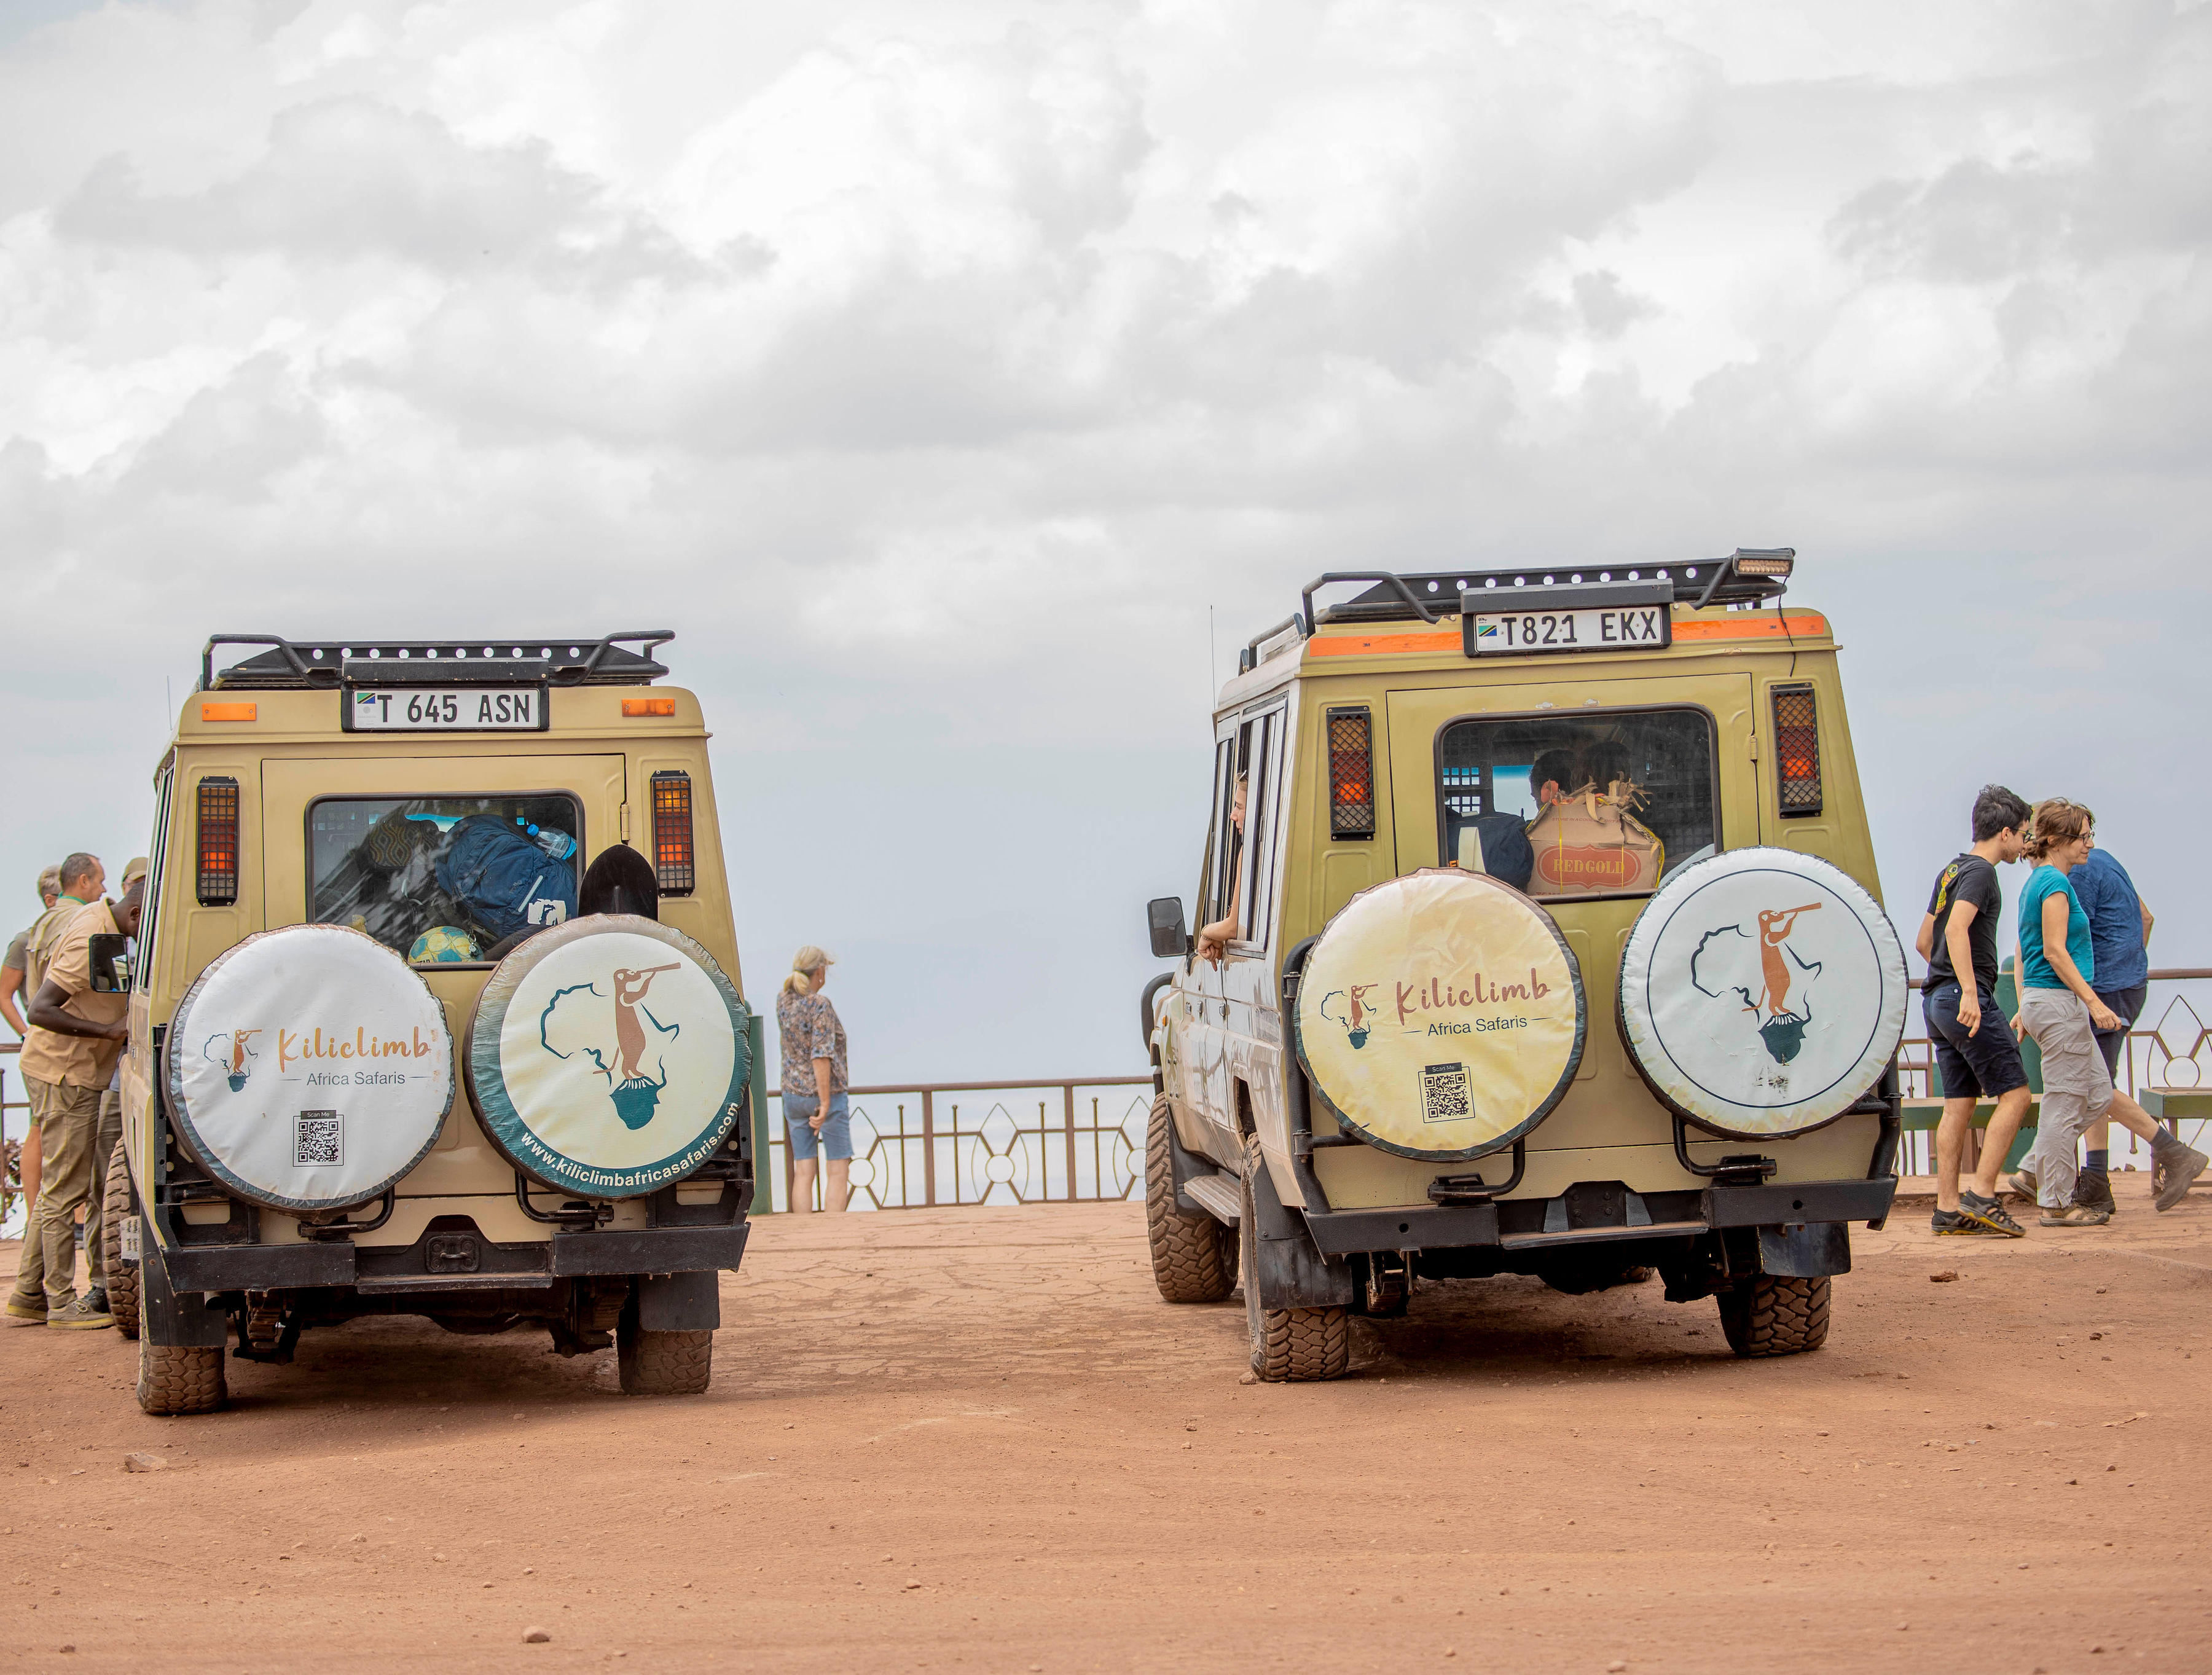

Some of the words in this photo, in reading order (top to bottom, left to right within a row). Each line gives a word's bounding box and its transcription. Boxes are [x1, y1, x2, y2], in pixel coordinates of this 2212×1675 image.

[1501, 614, 1578, 646] T821
[1600, 611, 1657, 641] EKX
[377, 694, 393, 723] T
[407, 694, 458, 723] 645
[478, 694, 530, 723] ASN
[1553, 859, 1583, 873] RED
[1586, 860, 1625, 874] GOLD
[1396, 968, 1551, 1026] Kiliclimb
[1427, 1021, 1471, 1037] Africa
[1476, 1015, 1528, 1032] Safaris
[278, 1026, 431, 1073] Kiliclimb
[307, 1072, 349, 1086] Africa
[355, 1072, 406, 1085] Safaris
[520, 1102, 739, 1187] www.kiliclimbafricasafaris.com
